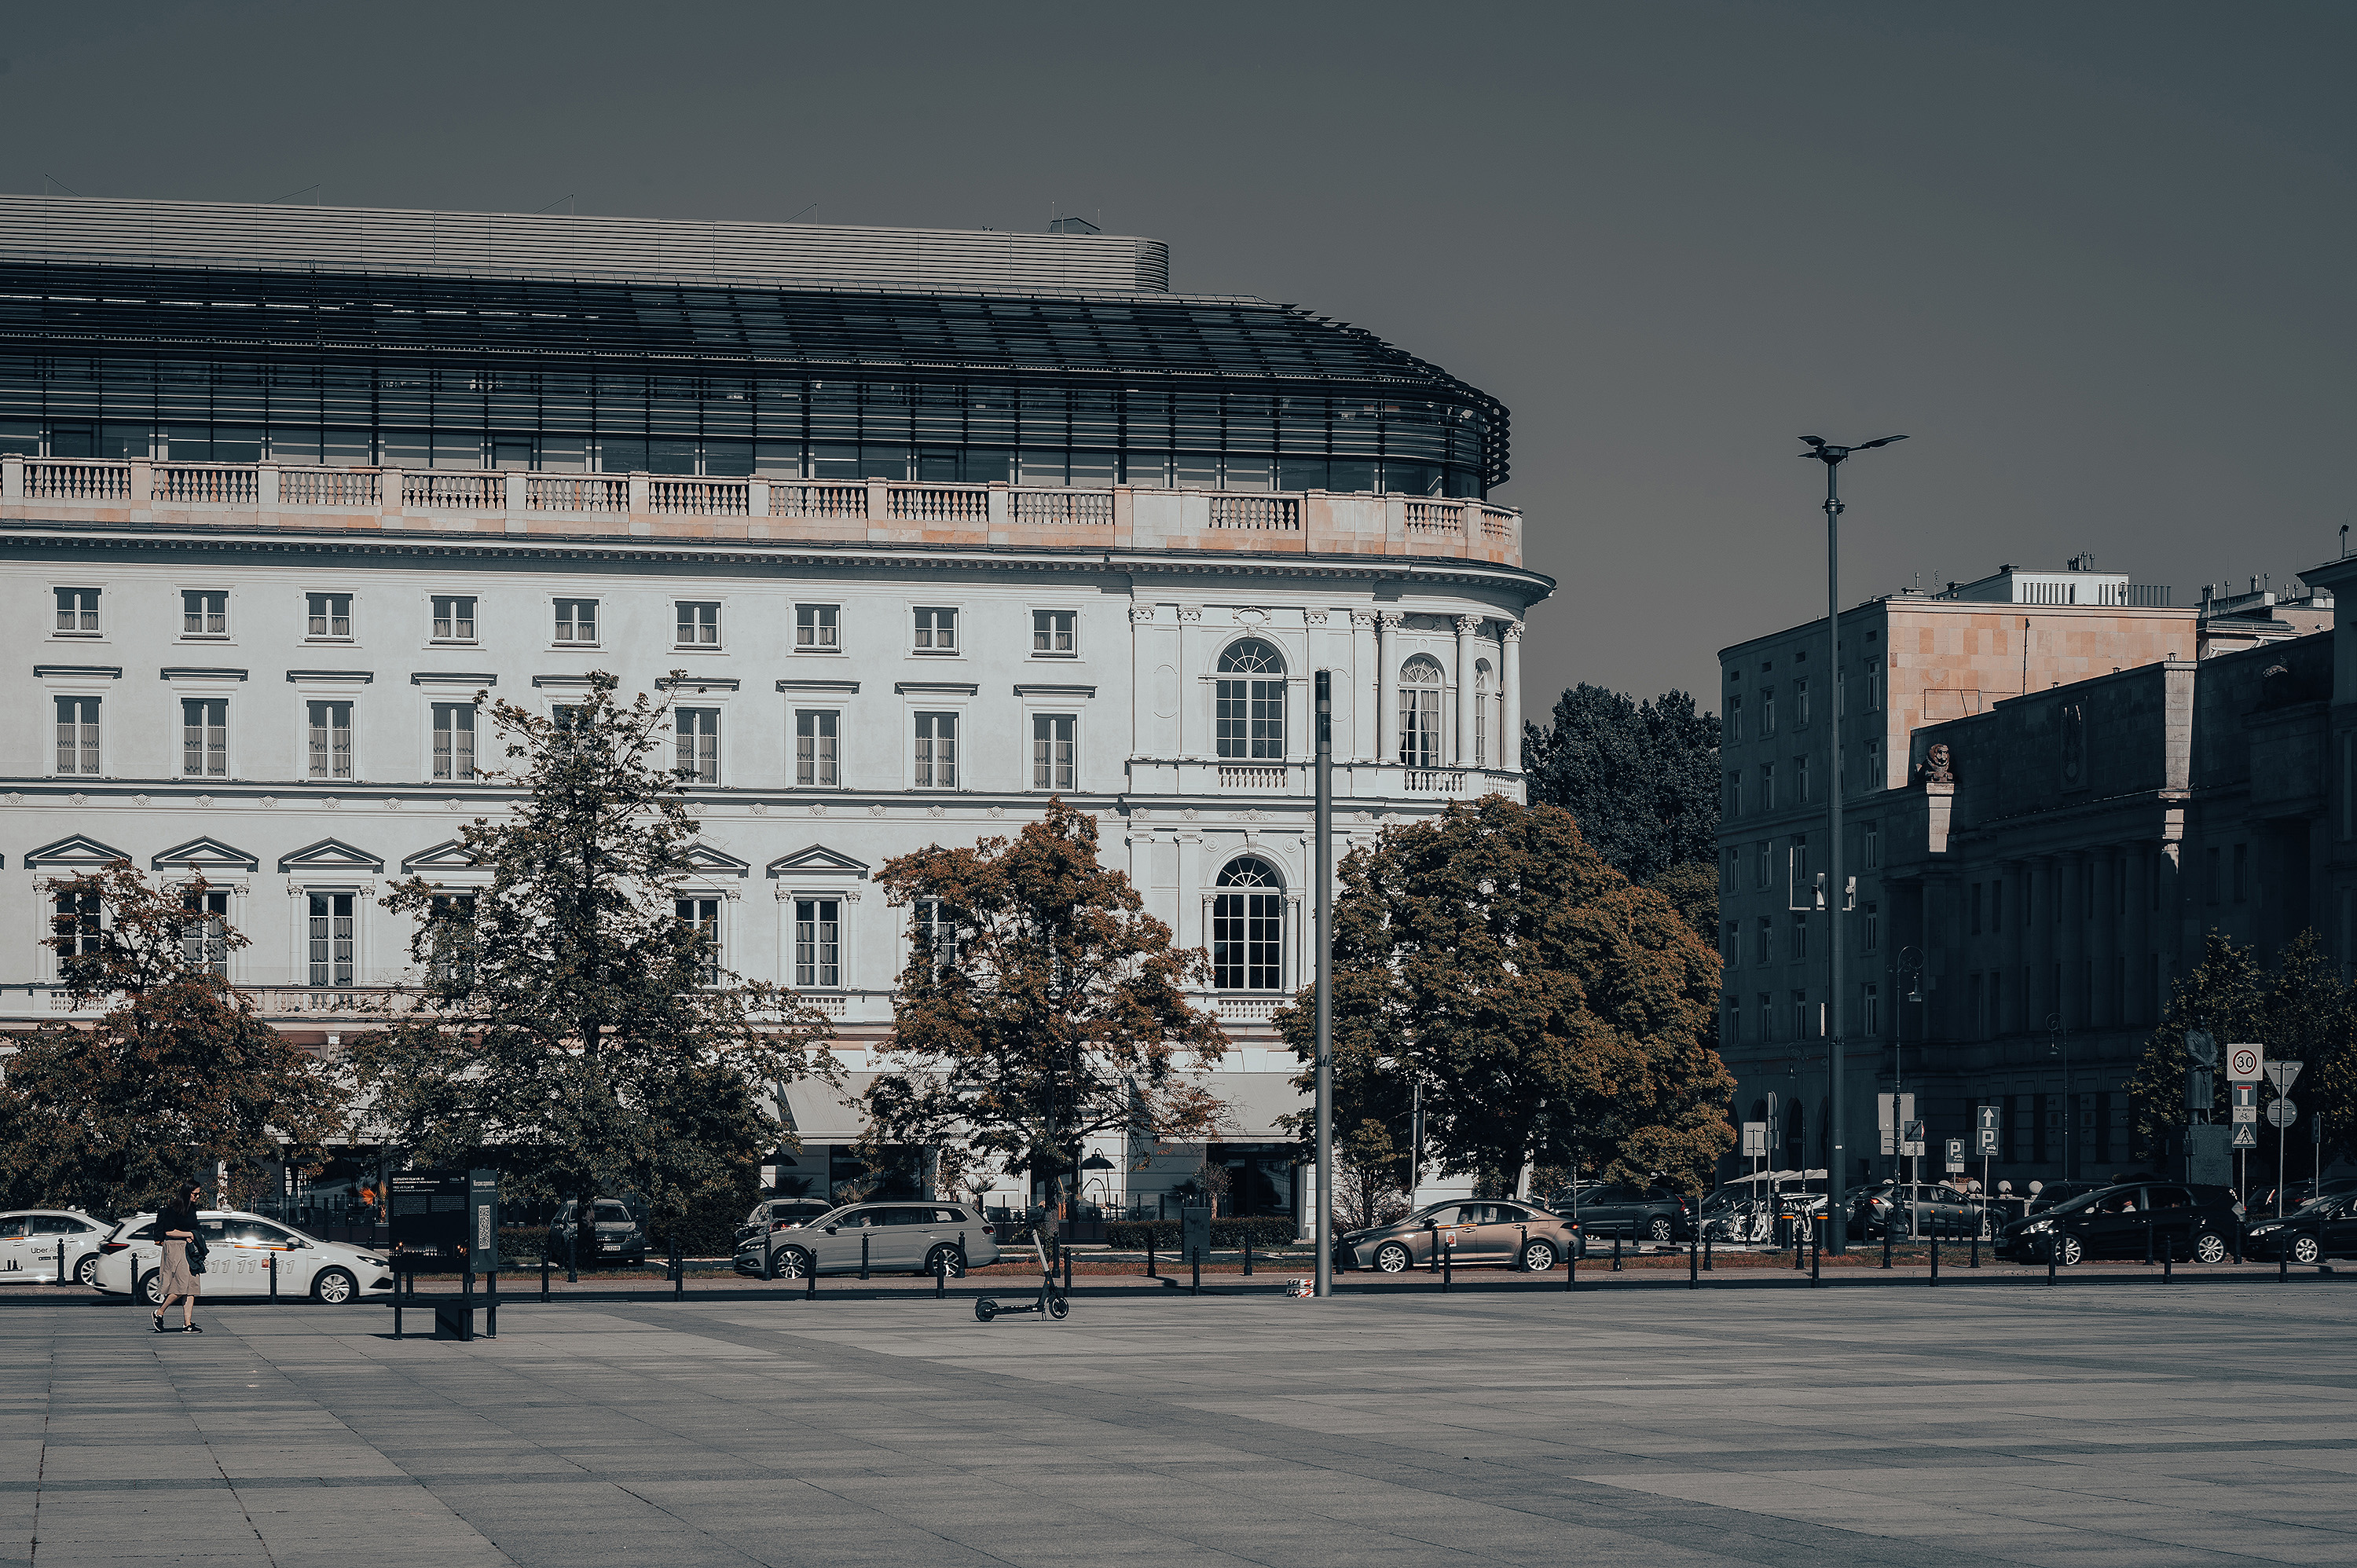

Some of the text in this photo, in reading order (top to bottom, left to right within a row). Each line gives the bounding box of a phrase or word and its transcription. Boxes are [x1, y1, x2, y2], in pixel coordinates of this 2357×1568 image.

[2237, 1056, 2253, 1068] 30
[1981, 1130, 1994, 1147] P
[1950, 1141, 1960, 1156] P
[49, 1245, 71, 1254] Airort
[237, 1259, 257, 1273] 11
